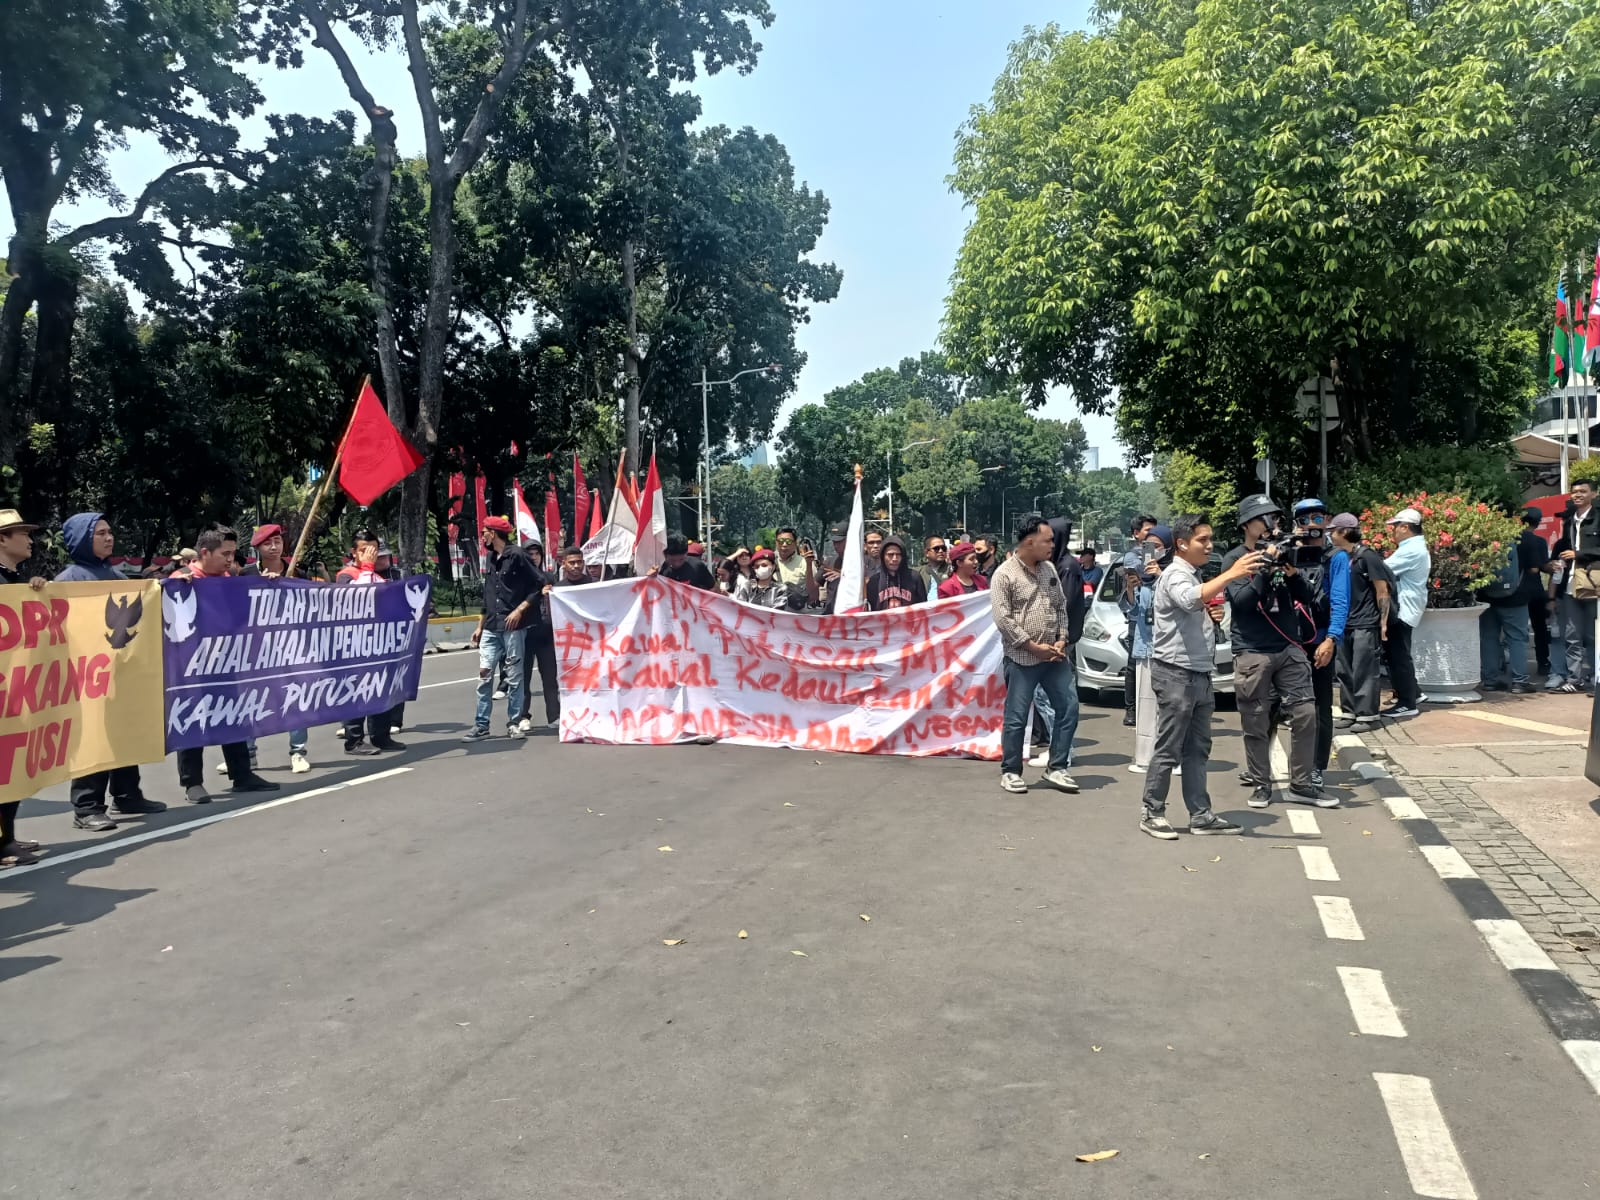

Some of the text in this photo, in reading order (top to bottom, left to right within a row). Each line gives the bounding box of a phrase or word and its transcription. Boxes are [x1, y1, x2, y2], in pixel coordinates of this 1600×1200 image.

[248, 586, 377, 627] TOLAK PILKADA
[184, 620, 415, 677] AKAL AKALAN PENGUASA
[902, 633, 976, 676] MK
[168, 686, 275, 736] KAWAL
[280, 666, 388, 717] PUTUSAN
[937, 672, 1007, 710] Rak
